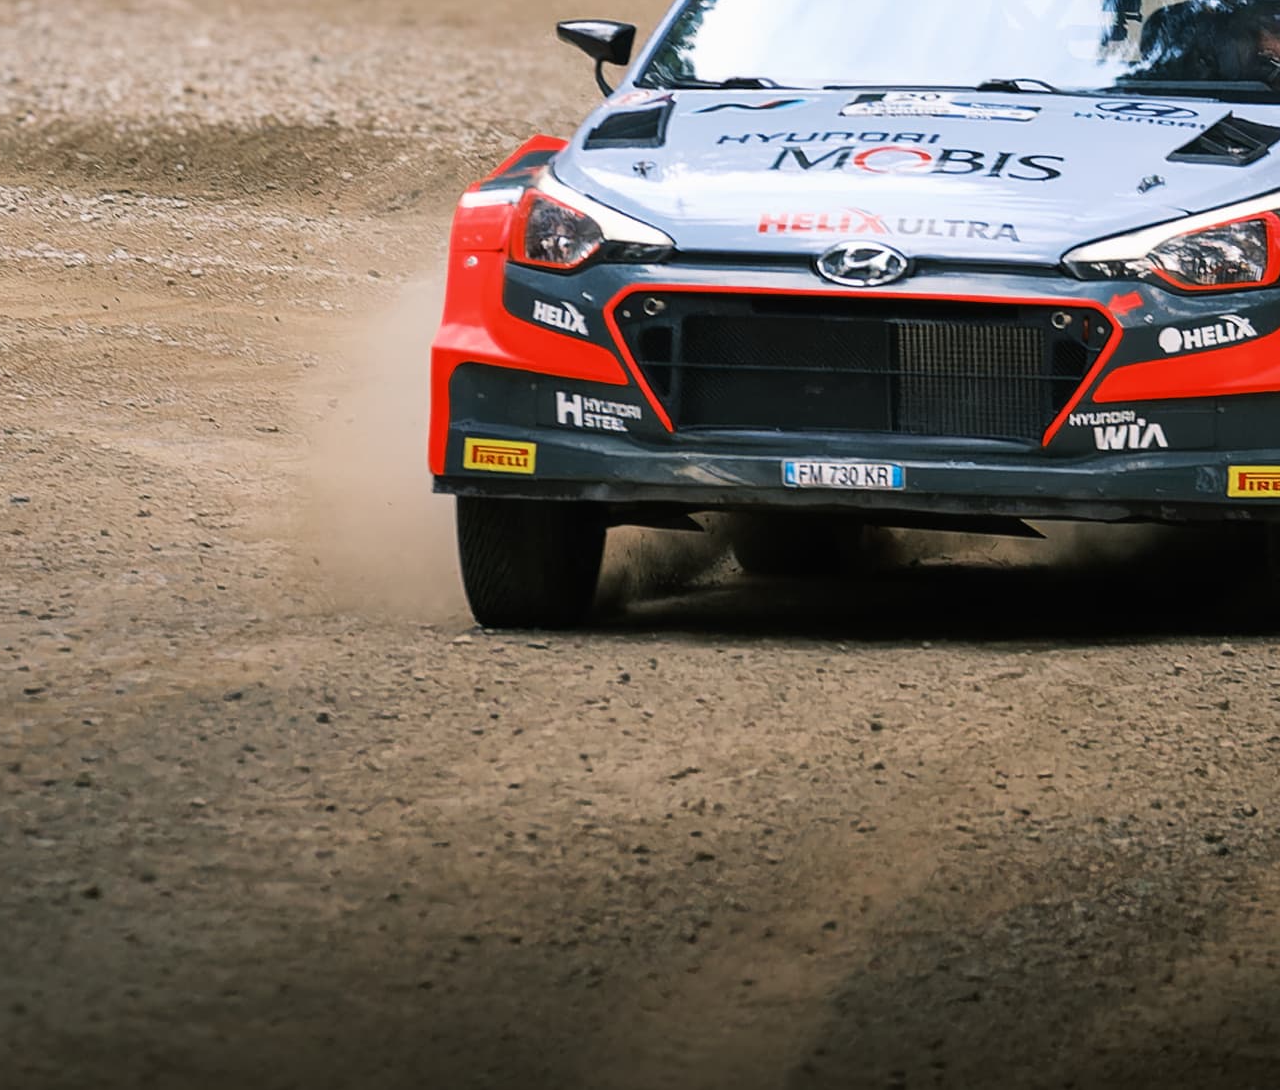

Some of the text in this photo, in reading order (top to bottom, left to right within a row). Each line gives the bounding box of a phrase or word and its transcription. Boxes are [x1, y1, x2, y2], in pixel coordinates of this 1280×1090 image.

[1073, 111, 1207, 130] HYUNDAI
[716, 132, 941, 145] HYUNDAI
[768, 145, 1065, 182] MOBIS
[758, 208, 1021, 243] HELIX ULTRA
[532, 300, 590, 337] HELIX
[1182, 314, 1258, 350] HELIX
[583, 396, 643, 421] HYUNDAI
[1068, 410, 1136, 427] HYUNDAI
[583, 412, 630, 433] STEEL
[472, 445, 529, 468] PIRELLI
[799, 464, 889, 487] FM 730 KR
